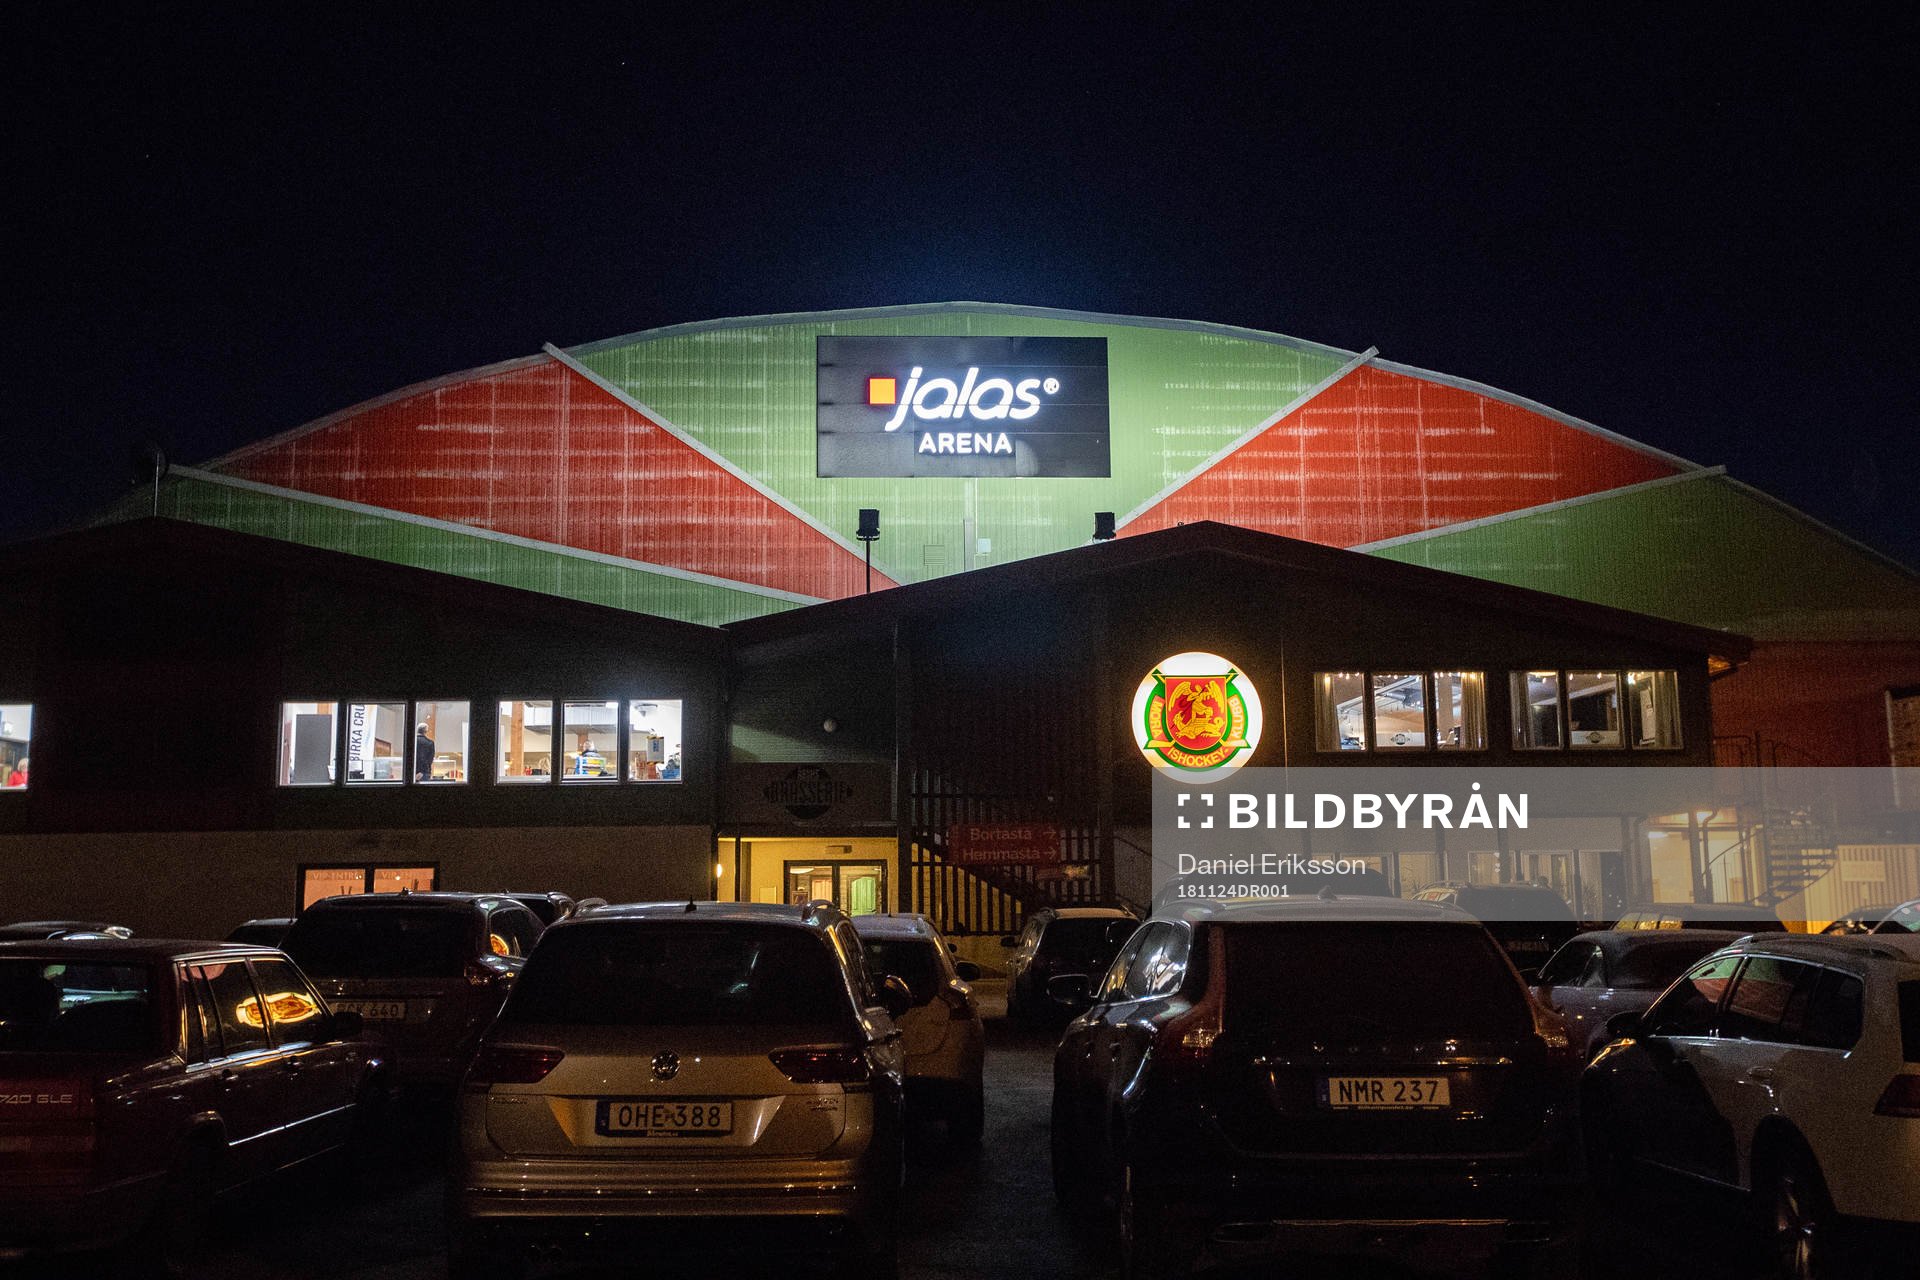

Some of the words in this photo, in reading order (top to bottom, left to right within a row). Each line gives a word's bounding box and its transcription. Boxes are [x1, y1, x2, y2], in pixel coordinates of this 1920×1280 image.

[918, 432, 1013, 454] ARENA
[1150, 700, 1163, 738] MORA
[1230, 698, 1243, 738] KLUBB
[349, 730, 363, 761] BIRKA
[370, 1003, 399, 1018] 640
[36, 1094, 73, 1104] GLE
[1338, 1080, 1384, 1102] NMR
[1393, 1080, 1439, 1102] 237
[618, 1105, 665, 1127] OHE
[673, 1105, 721, 1127] 388
